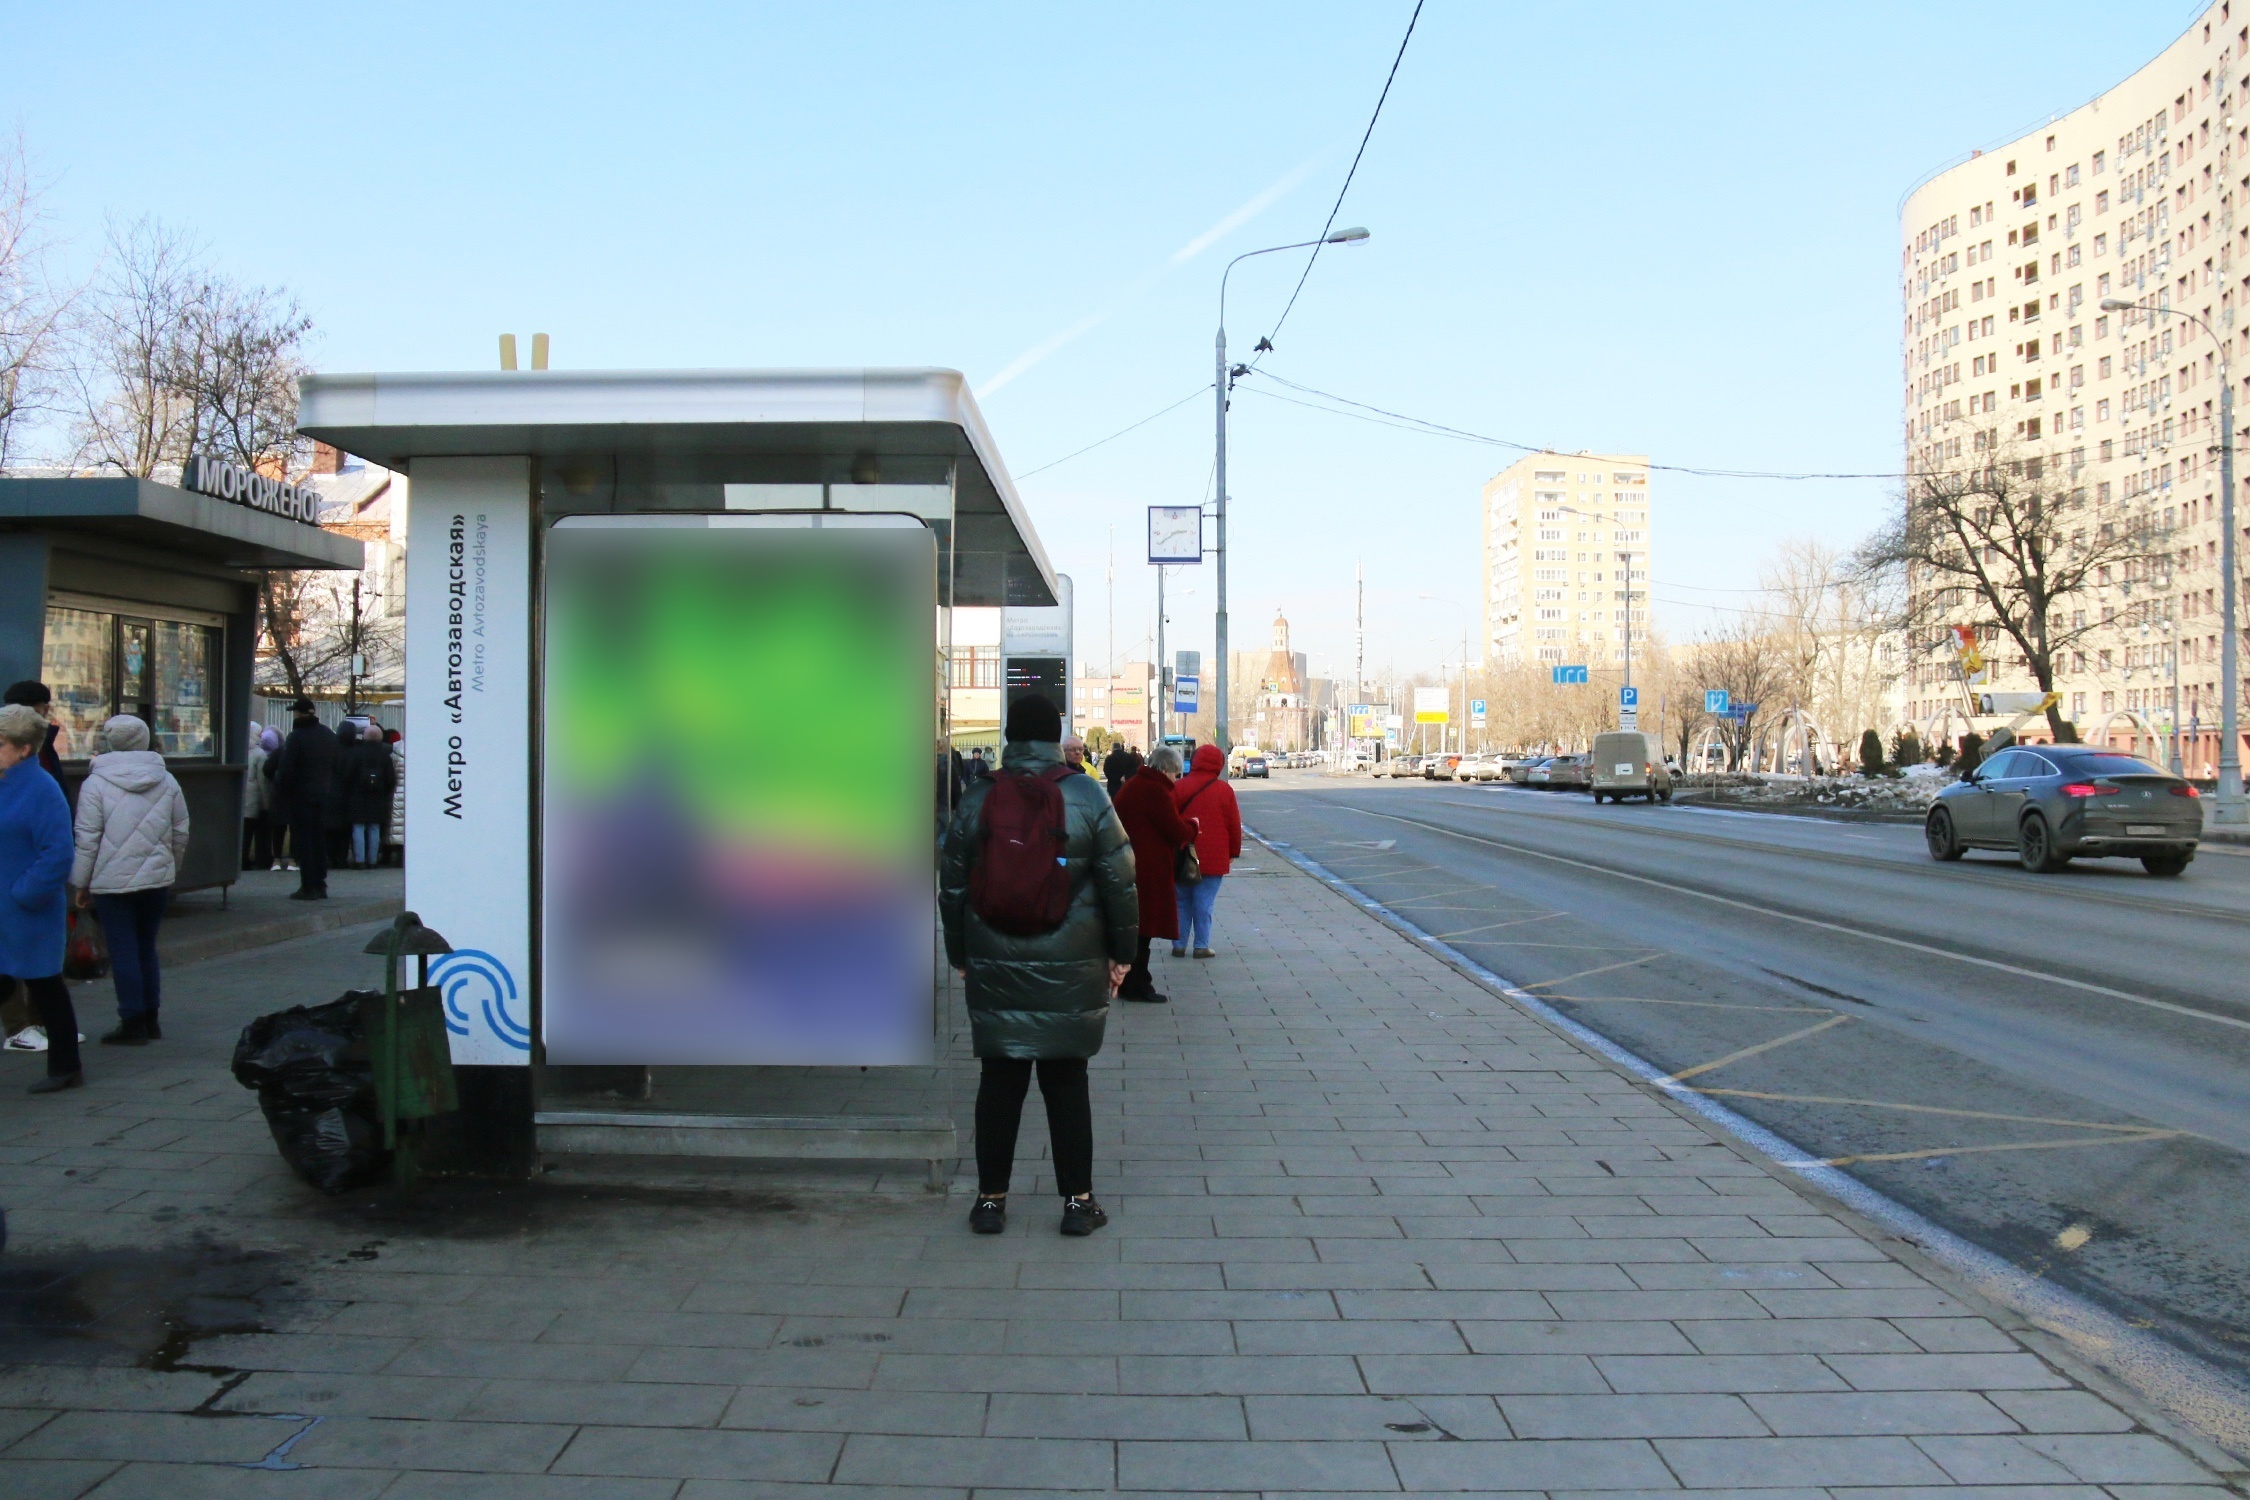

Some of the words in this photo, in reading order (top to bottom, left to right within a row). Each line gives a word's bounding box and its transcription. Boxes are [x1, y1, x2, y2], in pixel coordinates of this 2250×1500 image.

[197, 455, 324, 525] МОРОЖЕНОЕ
[472, 513, 488, 636] Avtozavodskaya
[443, 514, 466, 723] «Автозаводская»
[471, 645, 485, 692] Metro
[1623, 689, 1634, 704] P
[443, 735, 466, 819] Метро
